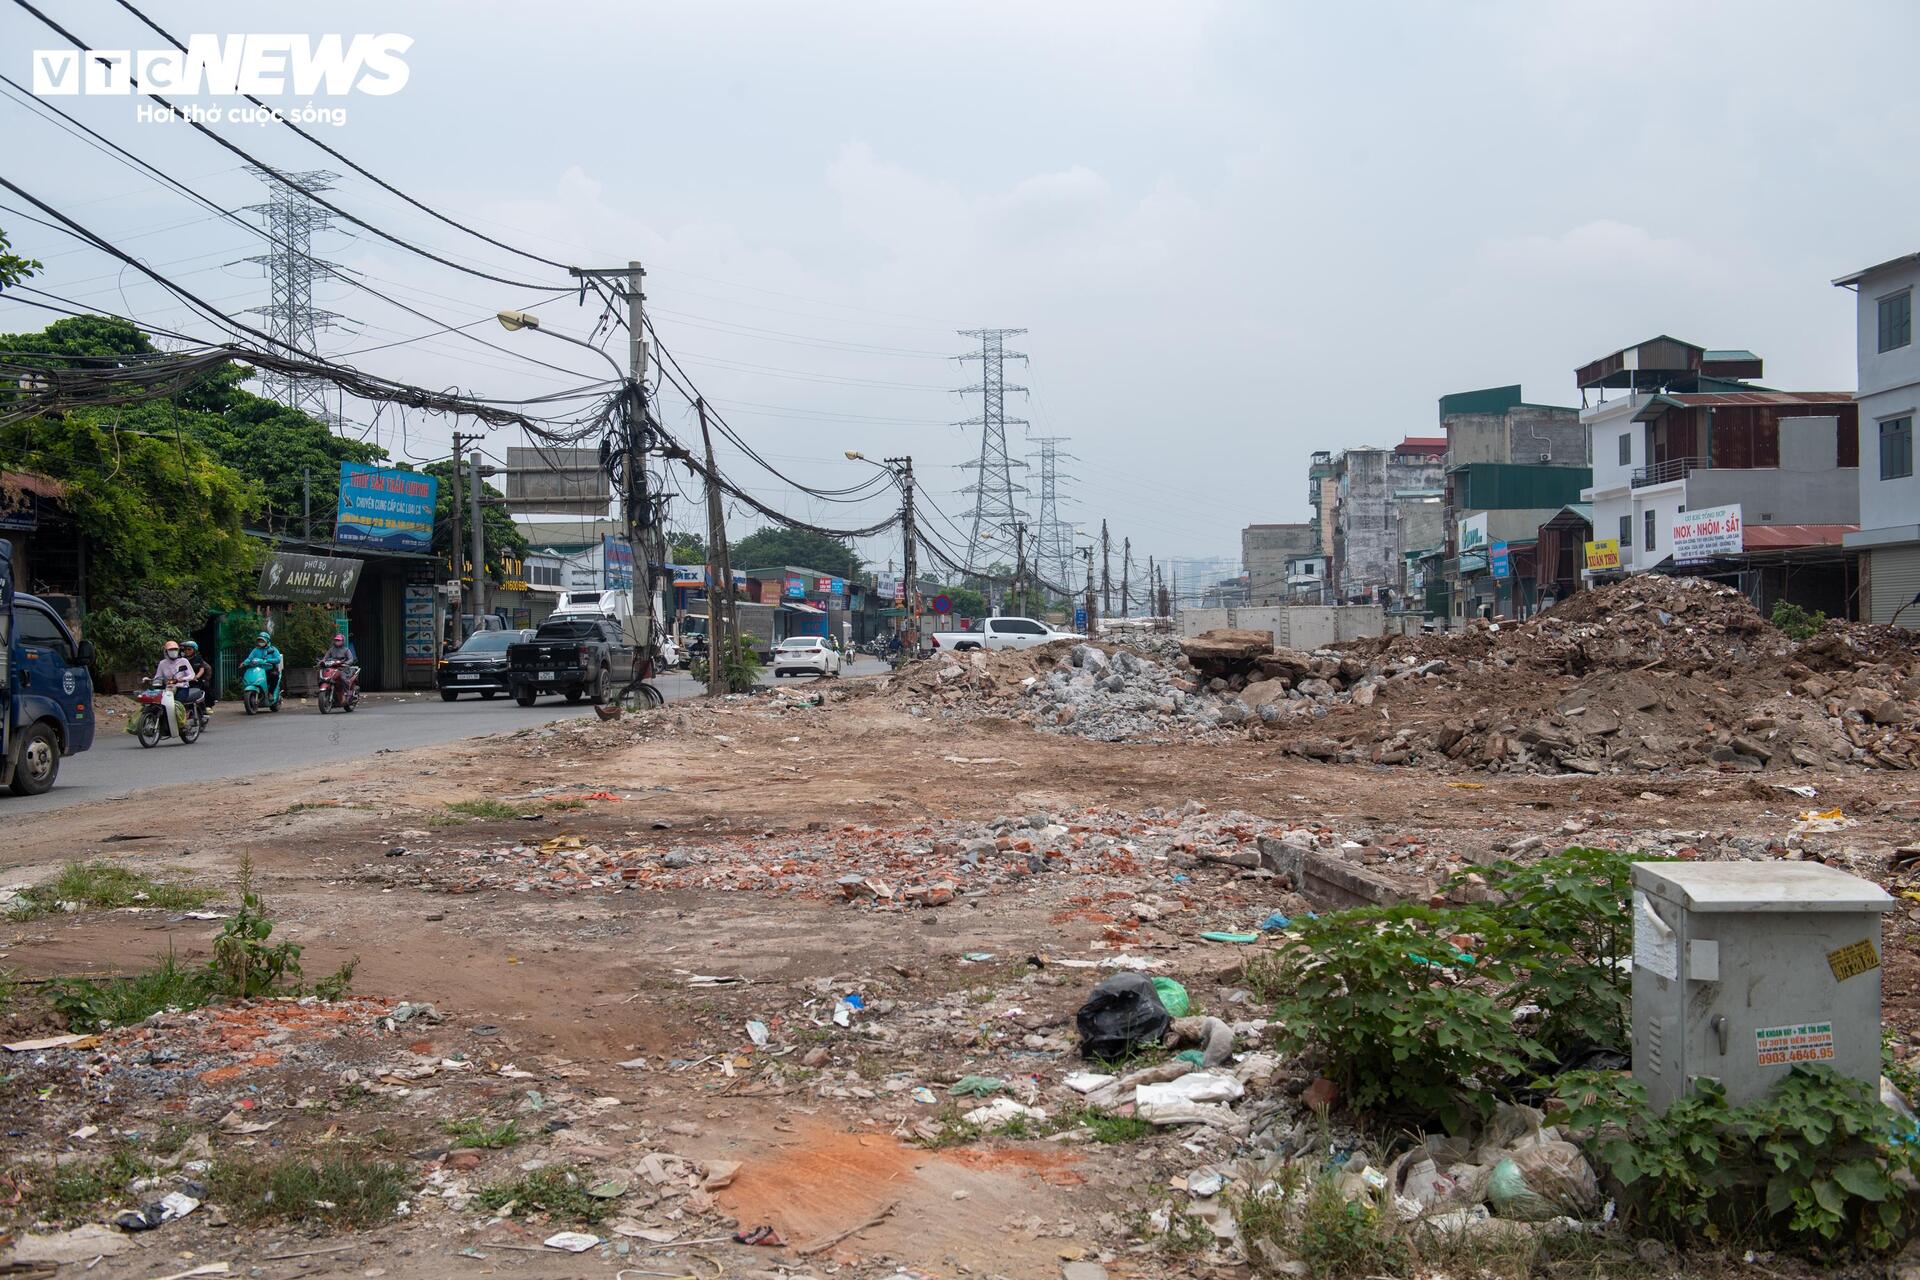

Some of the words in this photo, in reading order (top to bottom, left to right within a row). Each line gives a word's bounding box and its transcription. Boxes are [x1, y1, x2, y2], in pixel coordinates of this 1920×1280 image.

[1673, 525, 1691, 539] INOX
[1697, 519, 1720, 536] NHÔM
[1726, 512, 1740, 533] SẮT
[286, 571, 310, 585] ANH
[312, 570, 338, 587] THÁI
